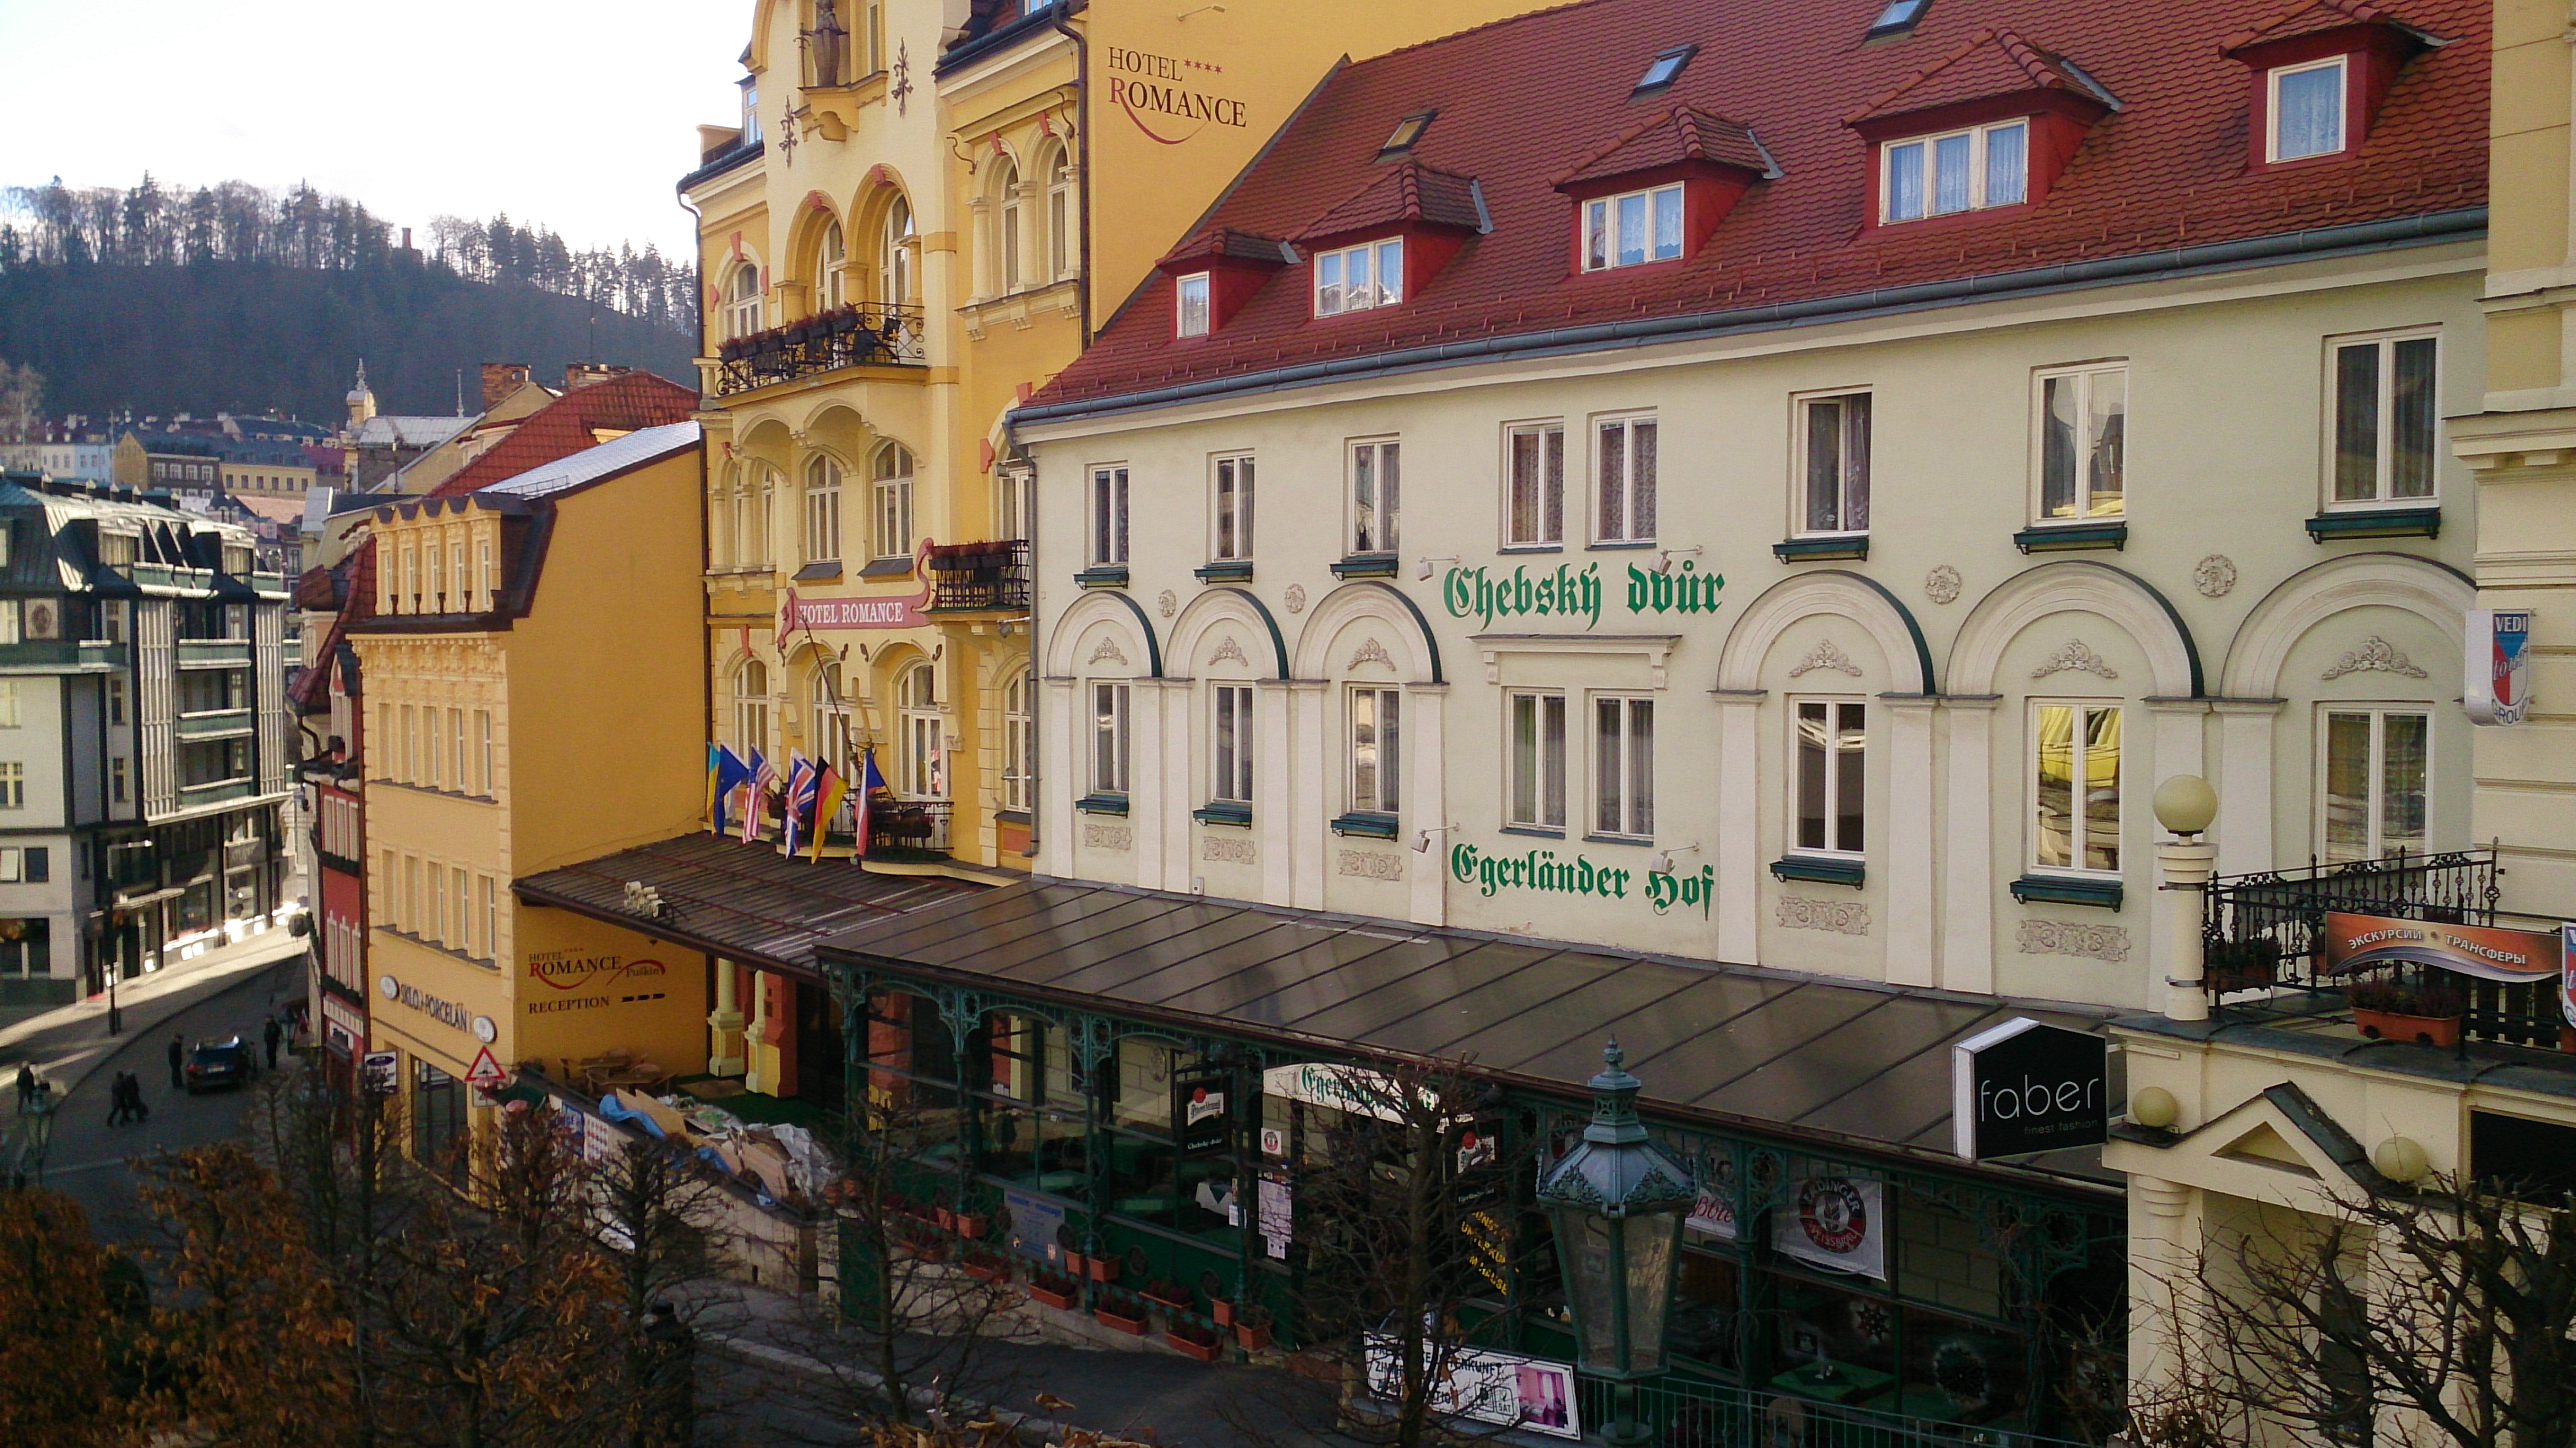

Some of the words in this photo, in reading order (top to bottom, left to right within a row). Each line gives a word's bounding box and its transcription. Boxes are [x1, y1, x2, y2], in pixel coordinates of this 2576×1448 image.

[1108, 46, 1183, 81] HOTEL
[1108, 76, 1247, 134] ROMANCE
[1442, 561, 1601, 631] Chebský
[798, 604, 839, 623] HOTEL
[841, 602, 904, 623] ROMANCE
[2495, 616, 2527, 632] VEDI
[2492, 696, 2528, 724] GROUP
[1452, 842, 1630, 899] Egerländer
[1645, 865, 1714, 921] Hof
[528, 951, 564, 962] HOTEL
[2347, 928, 2422, 950] ЭКСКУРСИИ
[2445, 934, 2526, 964] ТРАНСФЕРЫ
[528, 956, 622, 985] ROMANCE
[528, 996, 610, 1014] RECEPTION
[1981, 1074, 2099, 1122] faber
[2024, 1122, 2055, 1135] finest
[2058, 1119, 2098, 1132] fashion
[1498, 1403, 1511, 1413] SAT
